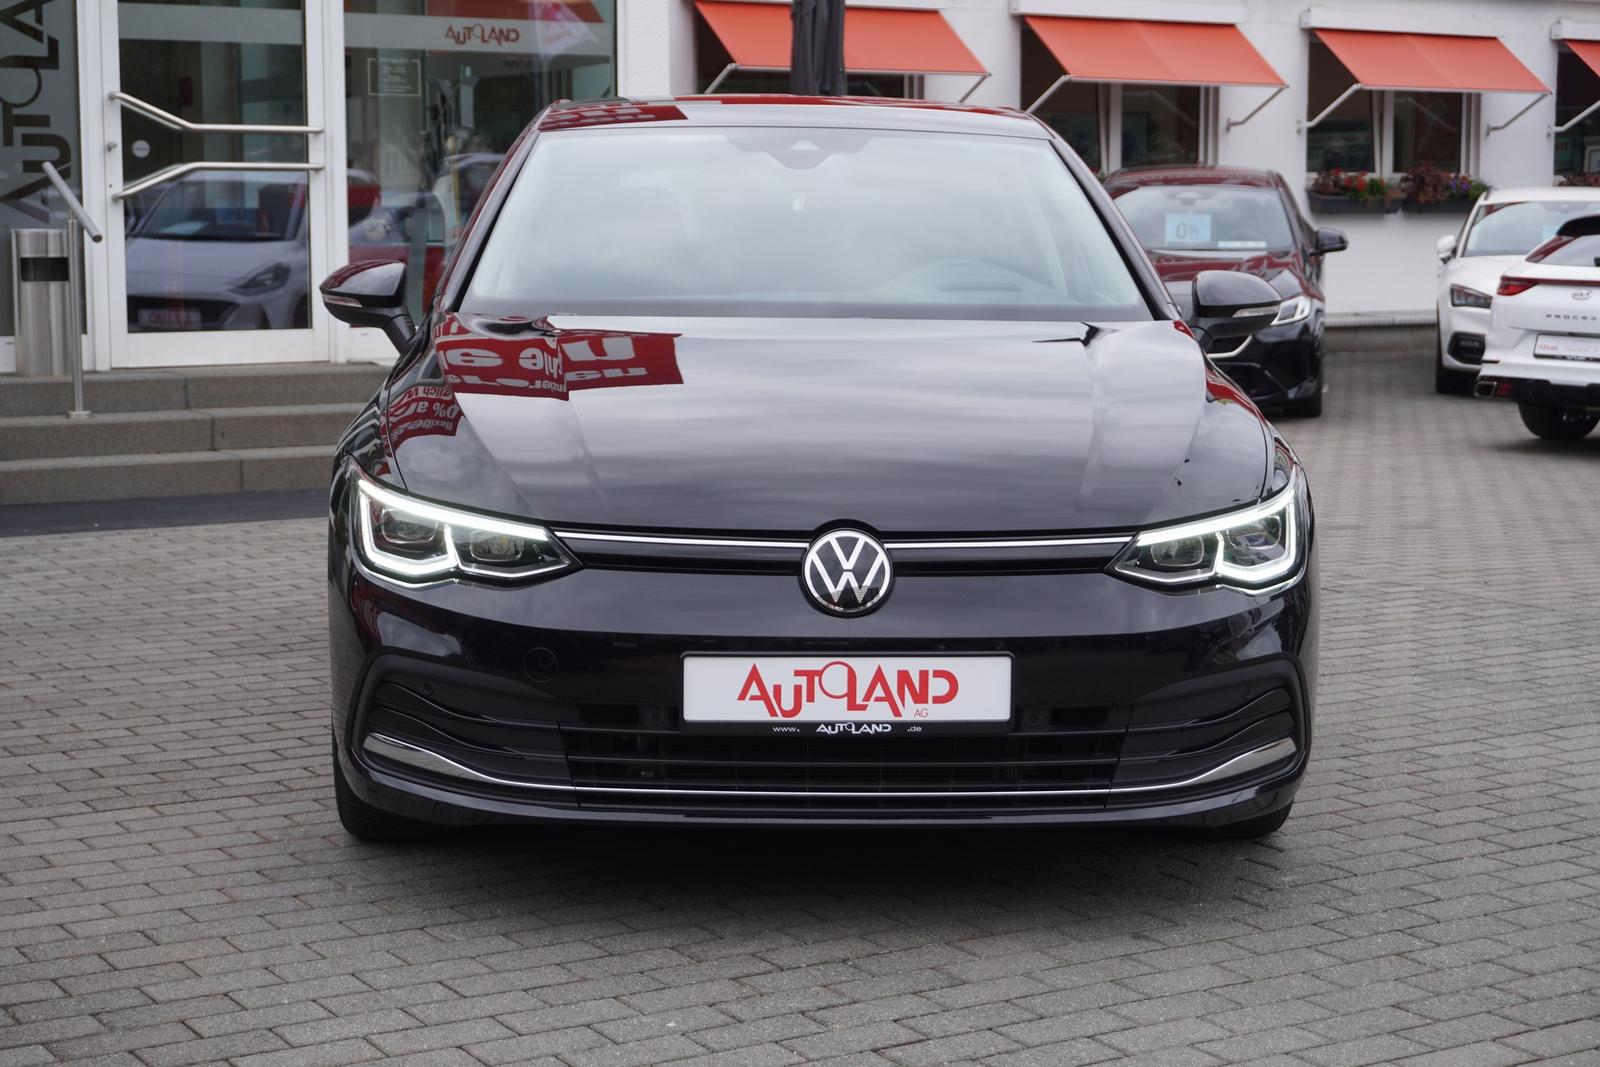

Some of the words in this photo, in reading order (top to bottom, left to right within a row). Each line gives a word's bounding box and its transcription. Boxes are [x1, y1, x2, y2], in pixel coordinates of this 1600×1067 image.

[444, 23, 520, 46] AUTOLAND
[805, 530, 891, 612] VW
[736, 660, 959, 718] AUTOLAND
[913, 708, 929, 718] AG
[815, 721, 892, 735] AUTOLAND
